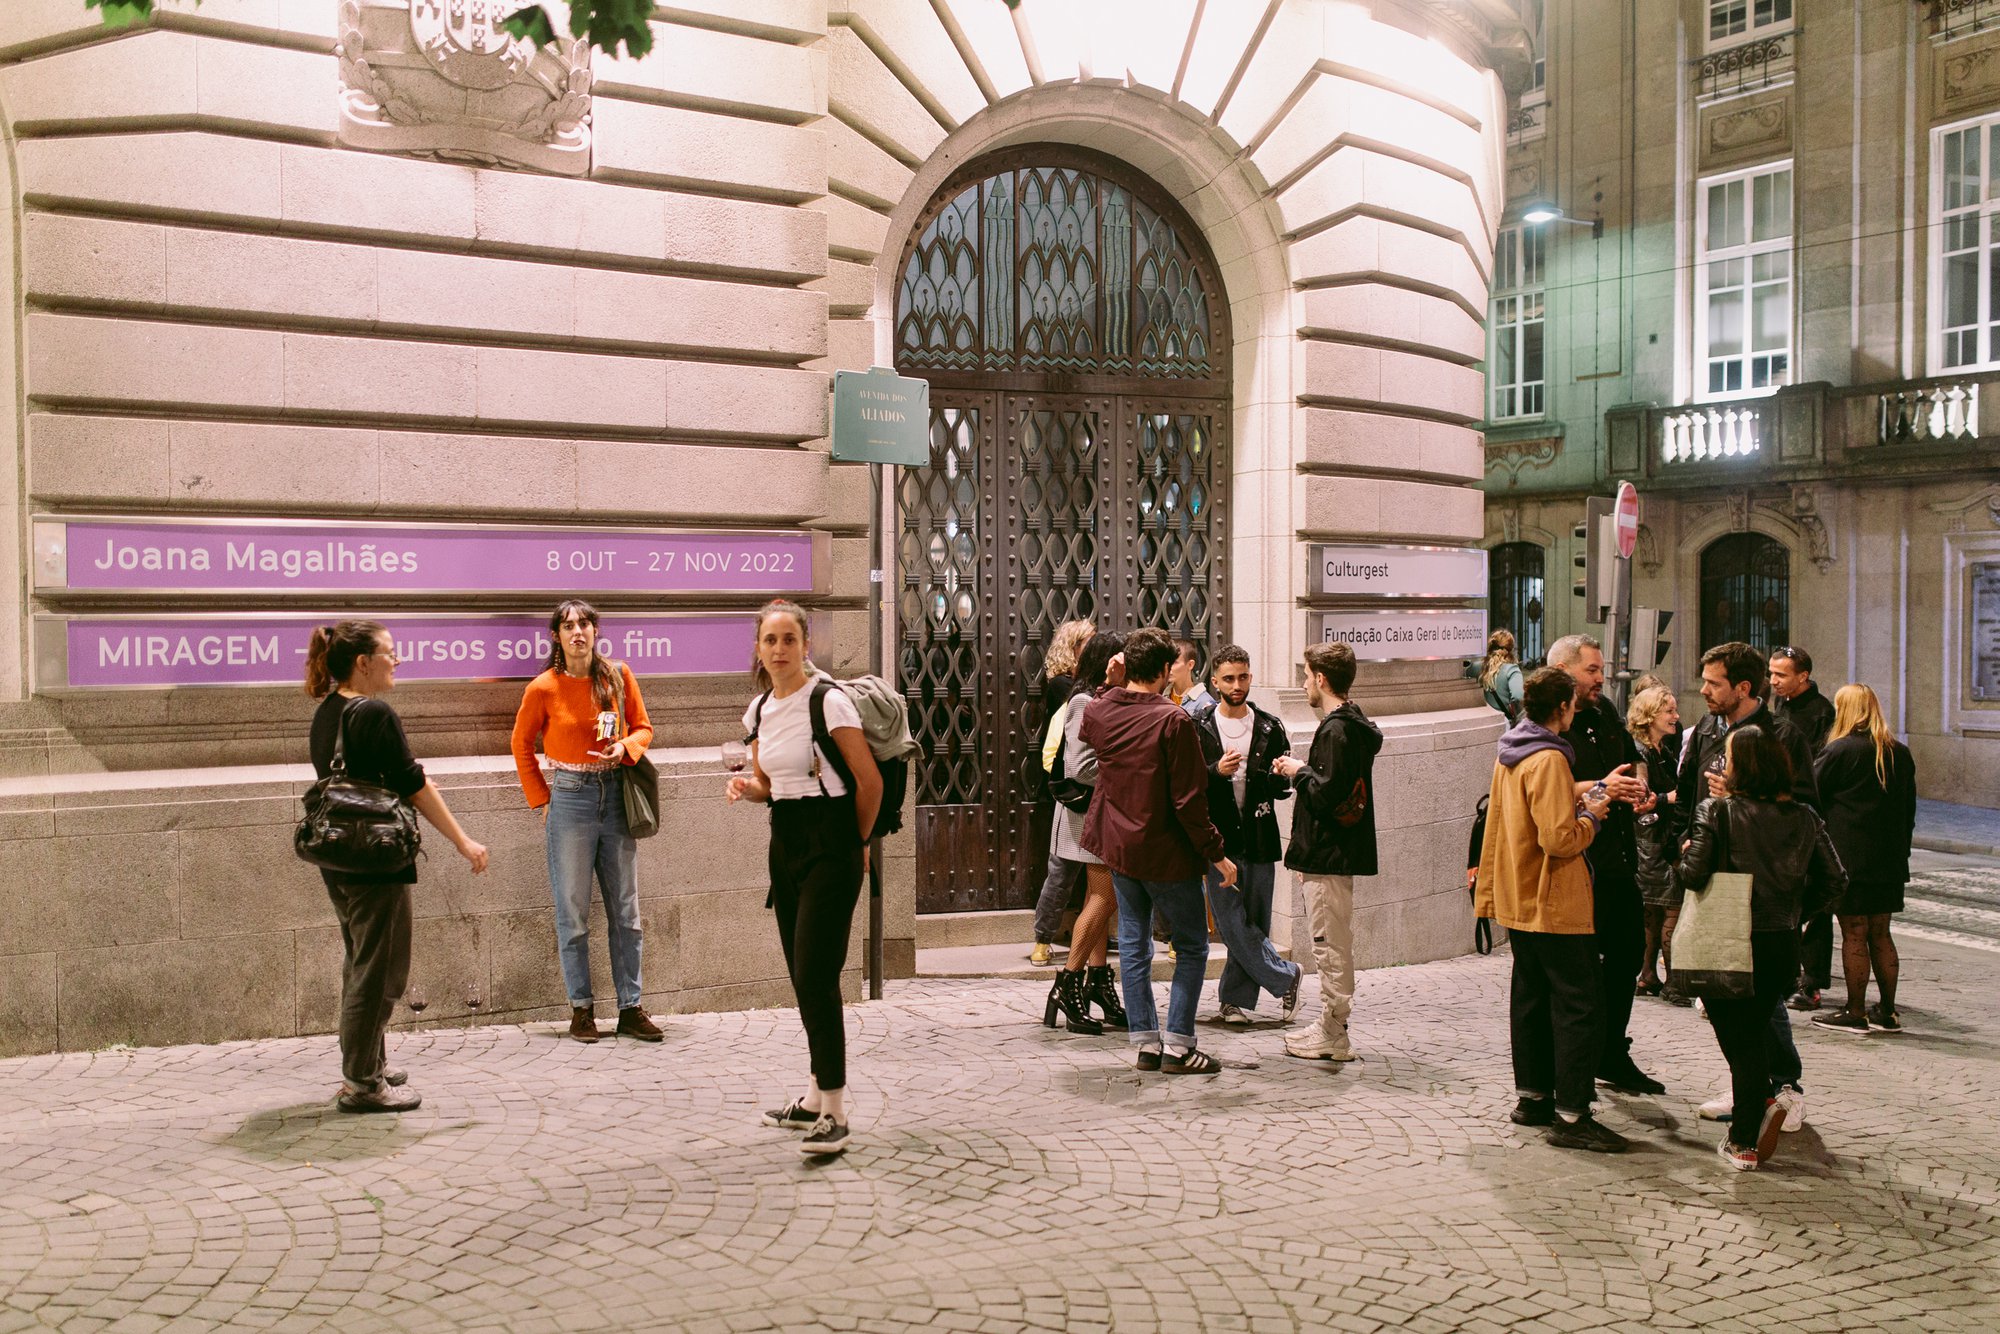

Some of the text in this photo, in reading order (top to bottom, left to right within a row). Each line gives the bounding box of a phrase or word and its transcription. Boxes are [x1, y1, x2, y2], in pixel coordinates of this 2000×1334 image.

[860, 389, 907, 402] AVENIDA DOS
[861, 407, 906, 423] ALIADOS
[94, 539, 419, 578] Joana Magalhães
[546, 550, 561, 571] 8
[569, 550, 617, 572] OUT
[648, 551, 677, 572] 27
[684, 552, 732, 572] NOV
[739, 552, 794, 573] 2022
[1325, 561, 1388, 580] Culturgest
[1325, 625, 1482, 646] Fundação Caixa Geral de Depósitos
[99, 635, 279, 667] MIRAGEM
[395, 639, 486, 663] ursos
[497, 631, 552, 660] sob
[596, 638, 613, 658] o
[622, 630, 672, 658] fim
